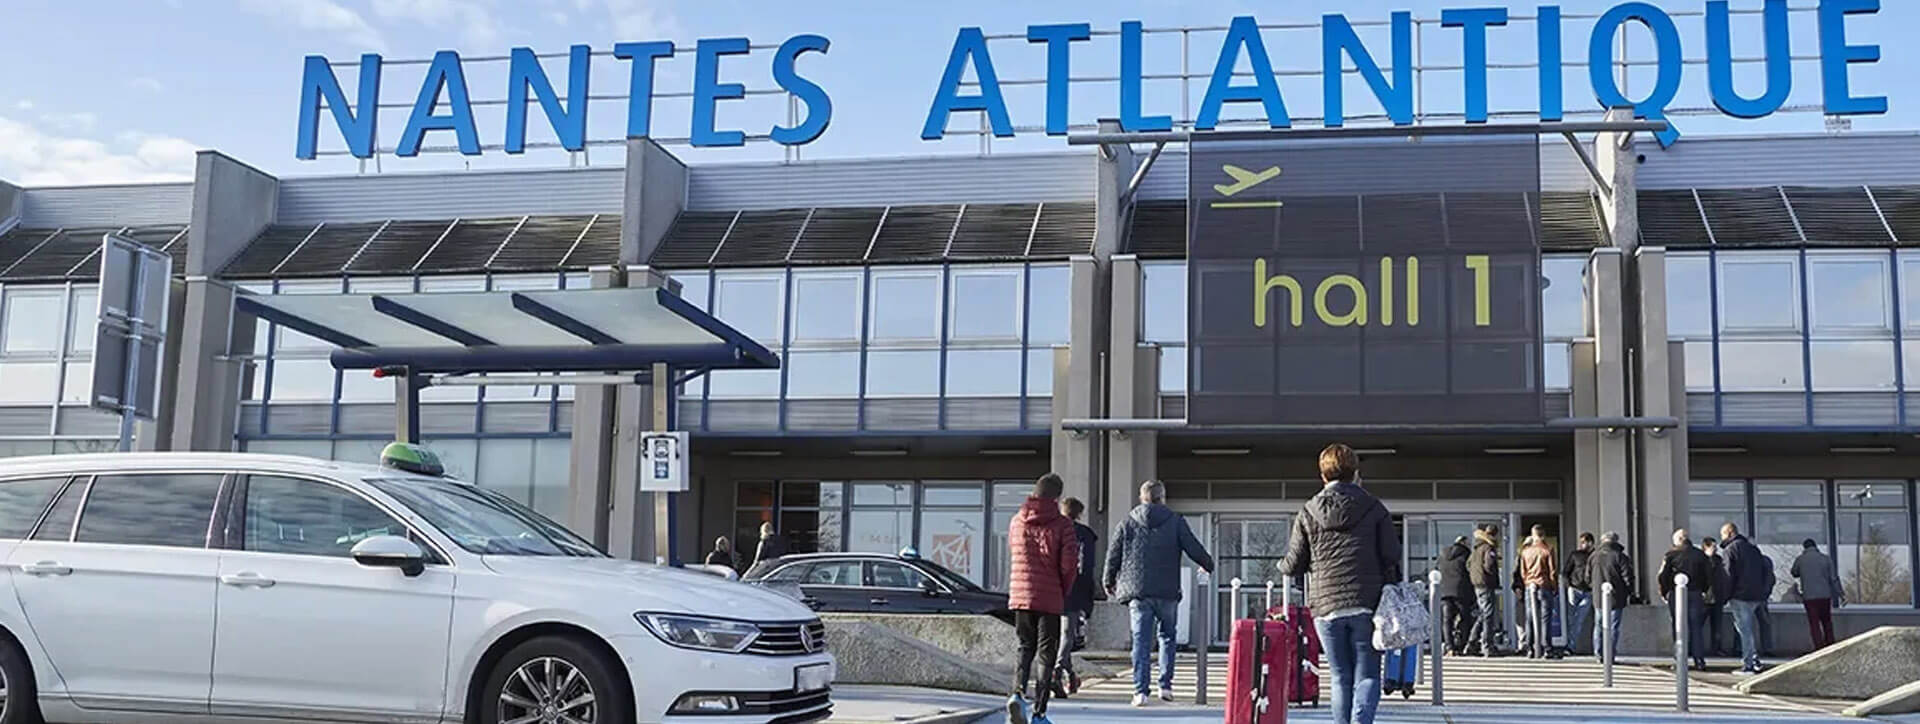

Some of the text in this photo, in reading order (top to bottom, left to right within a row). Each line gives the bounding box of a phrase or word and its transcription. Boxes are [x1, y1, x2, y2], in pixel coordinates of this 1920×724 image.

[296, 0, 1889, 159] NANTES ATLANTIQUE
[1253, 255, 1490, 327] hall 1
